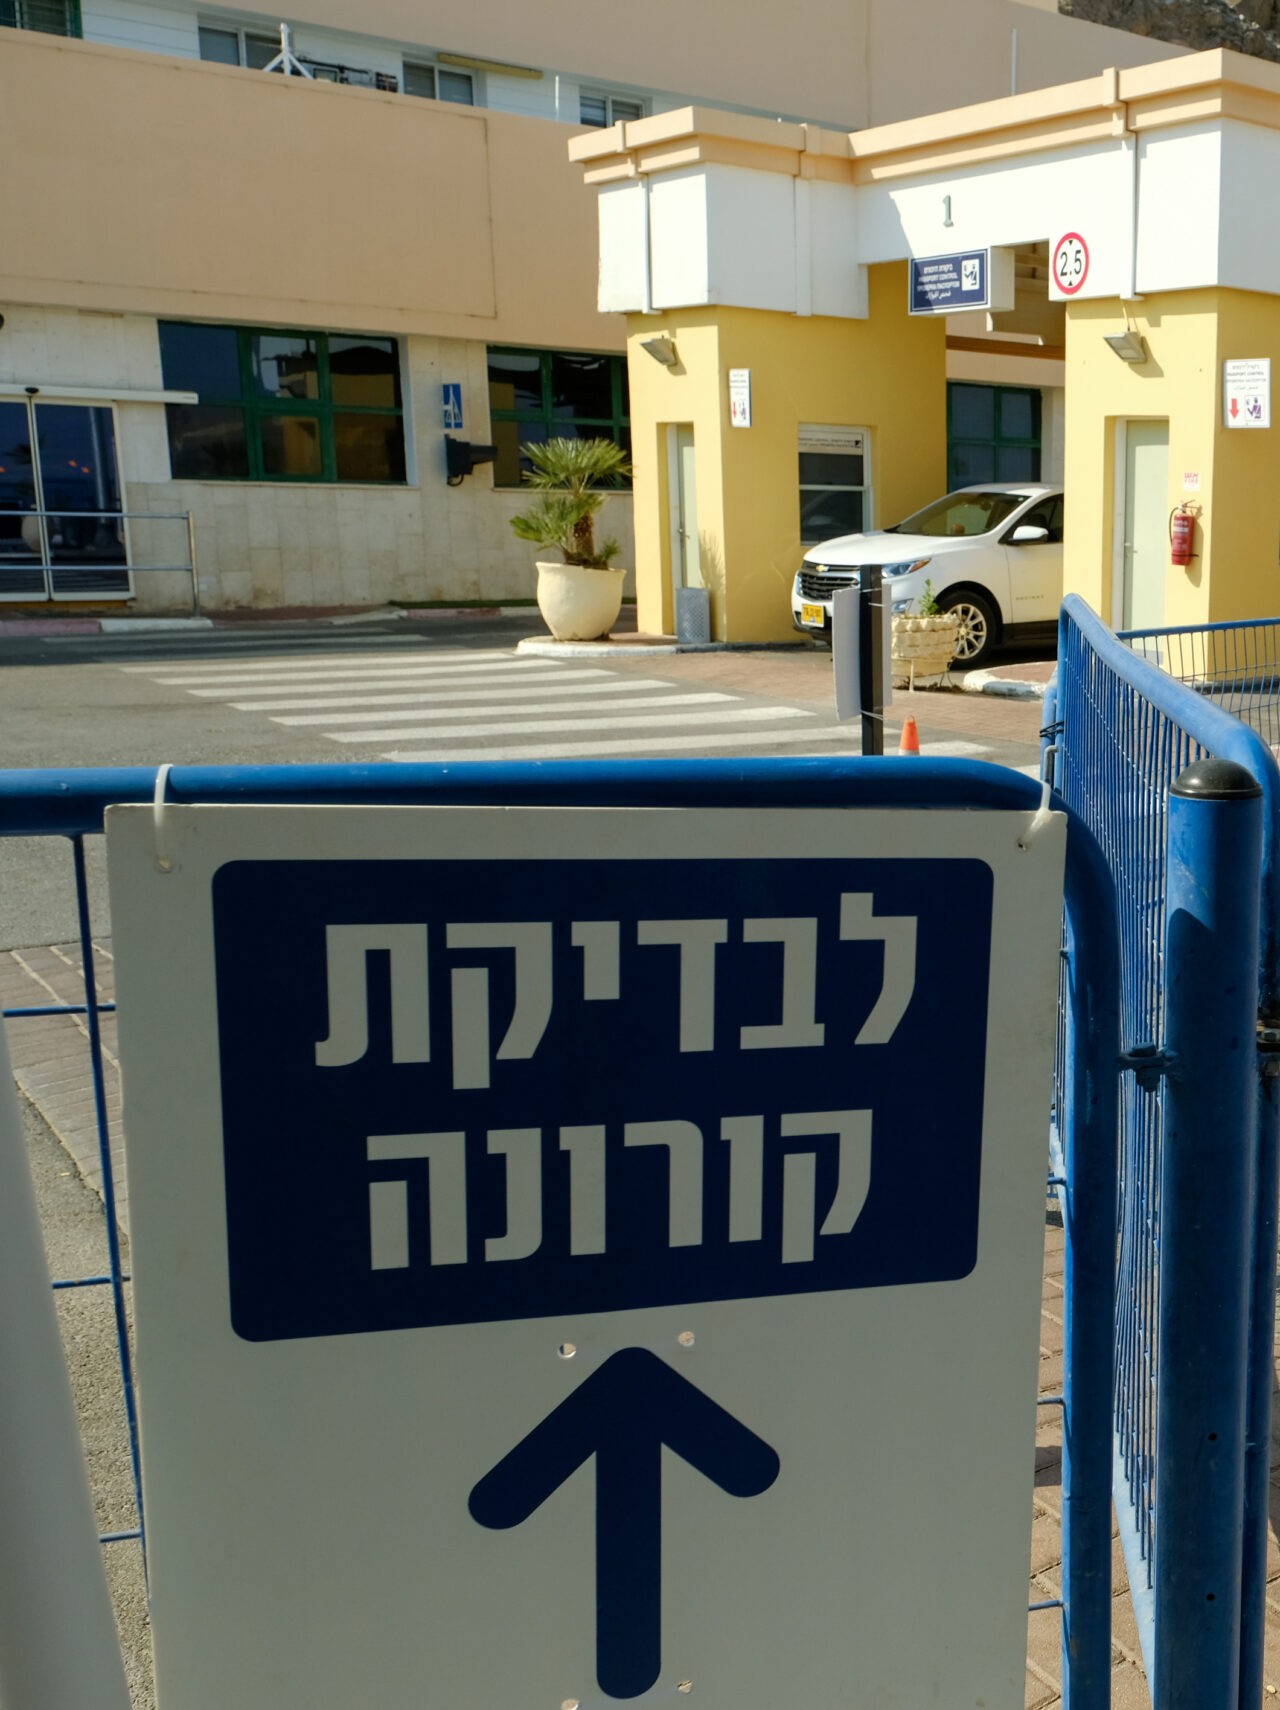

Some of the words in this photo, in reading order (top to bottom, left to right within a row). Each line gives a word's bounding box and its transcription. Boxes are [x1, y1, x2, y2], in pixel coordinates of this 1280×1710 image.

[942, 194, 954, 228] 1
[1059, 249, 1082, 277] 2.5
[314, 892, 918, 1089] לבדיקת
[366, 1109, 873, 1270] קורונה
